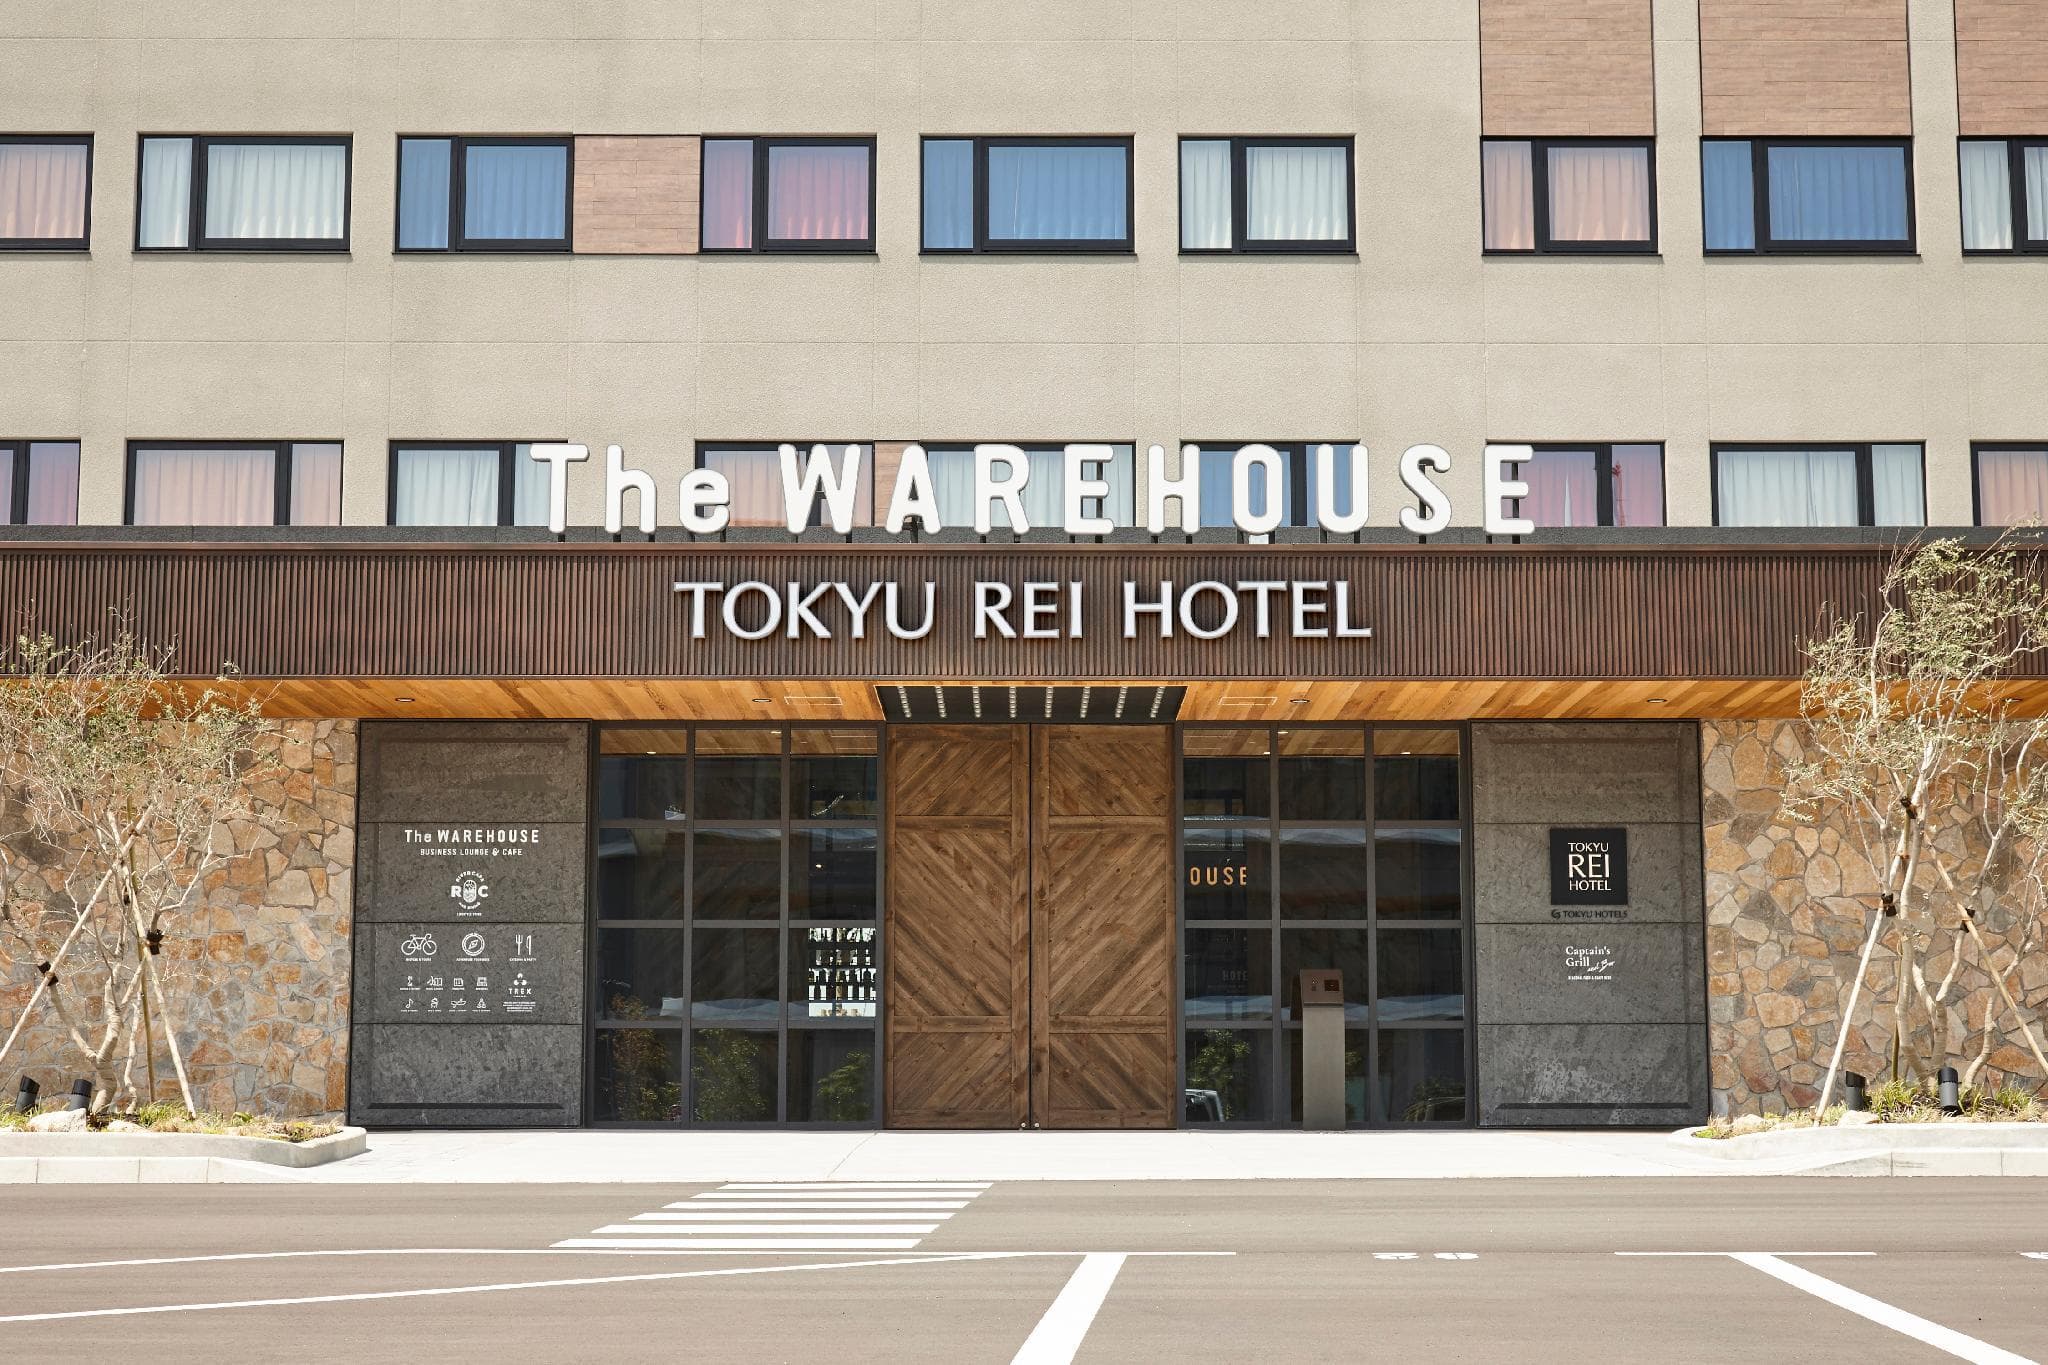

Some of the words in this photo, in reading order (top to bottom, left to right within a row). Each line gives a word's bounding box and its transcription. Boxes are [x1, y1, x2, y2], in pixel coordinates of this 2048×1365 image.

[529, 443, 730, 534] The
[778, 443, 1535, 535] WAREHOUSE
[673, 580, 936, 640] TOKYU
[973, 580, 1083, 640] REI
[1123, 580, 1373, 640] HOTEL
[405, 829, 432, 843] The
[437, 829, 539, 843] WAREHOUSE
[420, 848, 457, 856] BUSINESS
[502, 848, 523, 856] CAFE
[1568, 842, 1609, 853] TOKYU
[1568, 854, 1610, 878] REI
[1190, 866, 1247, 886] OUSE
[1569, 880, 1612, 891] HOTEL
[1562, 909, 1594, 919] TOKYU
[1595, 909, 1628, 919] HOTELS
[1565, 945, 1611, 959] Captain's
[1565, 957, 1590, 967] Grill
